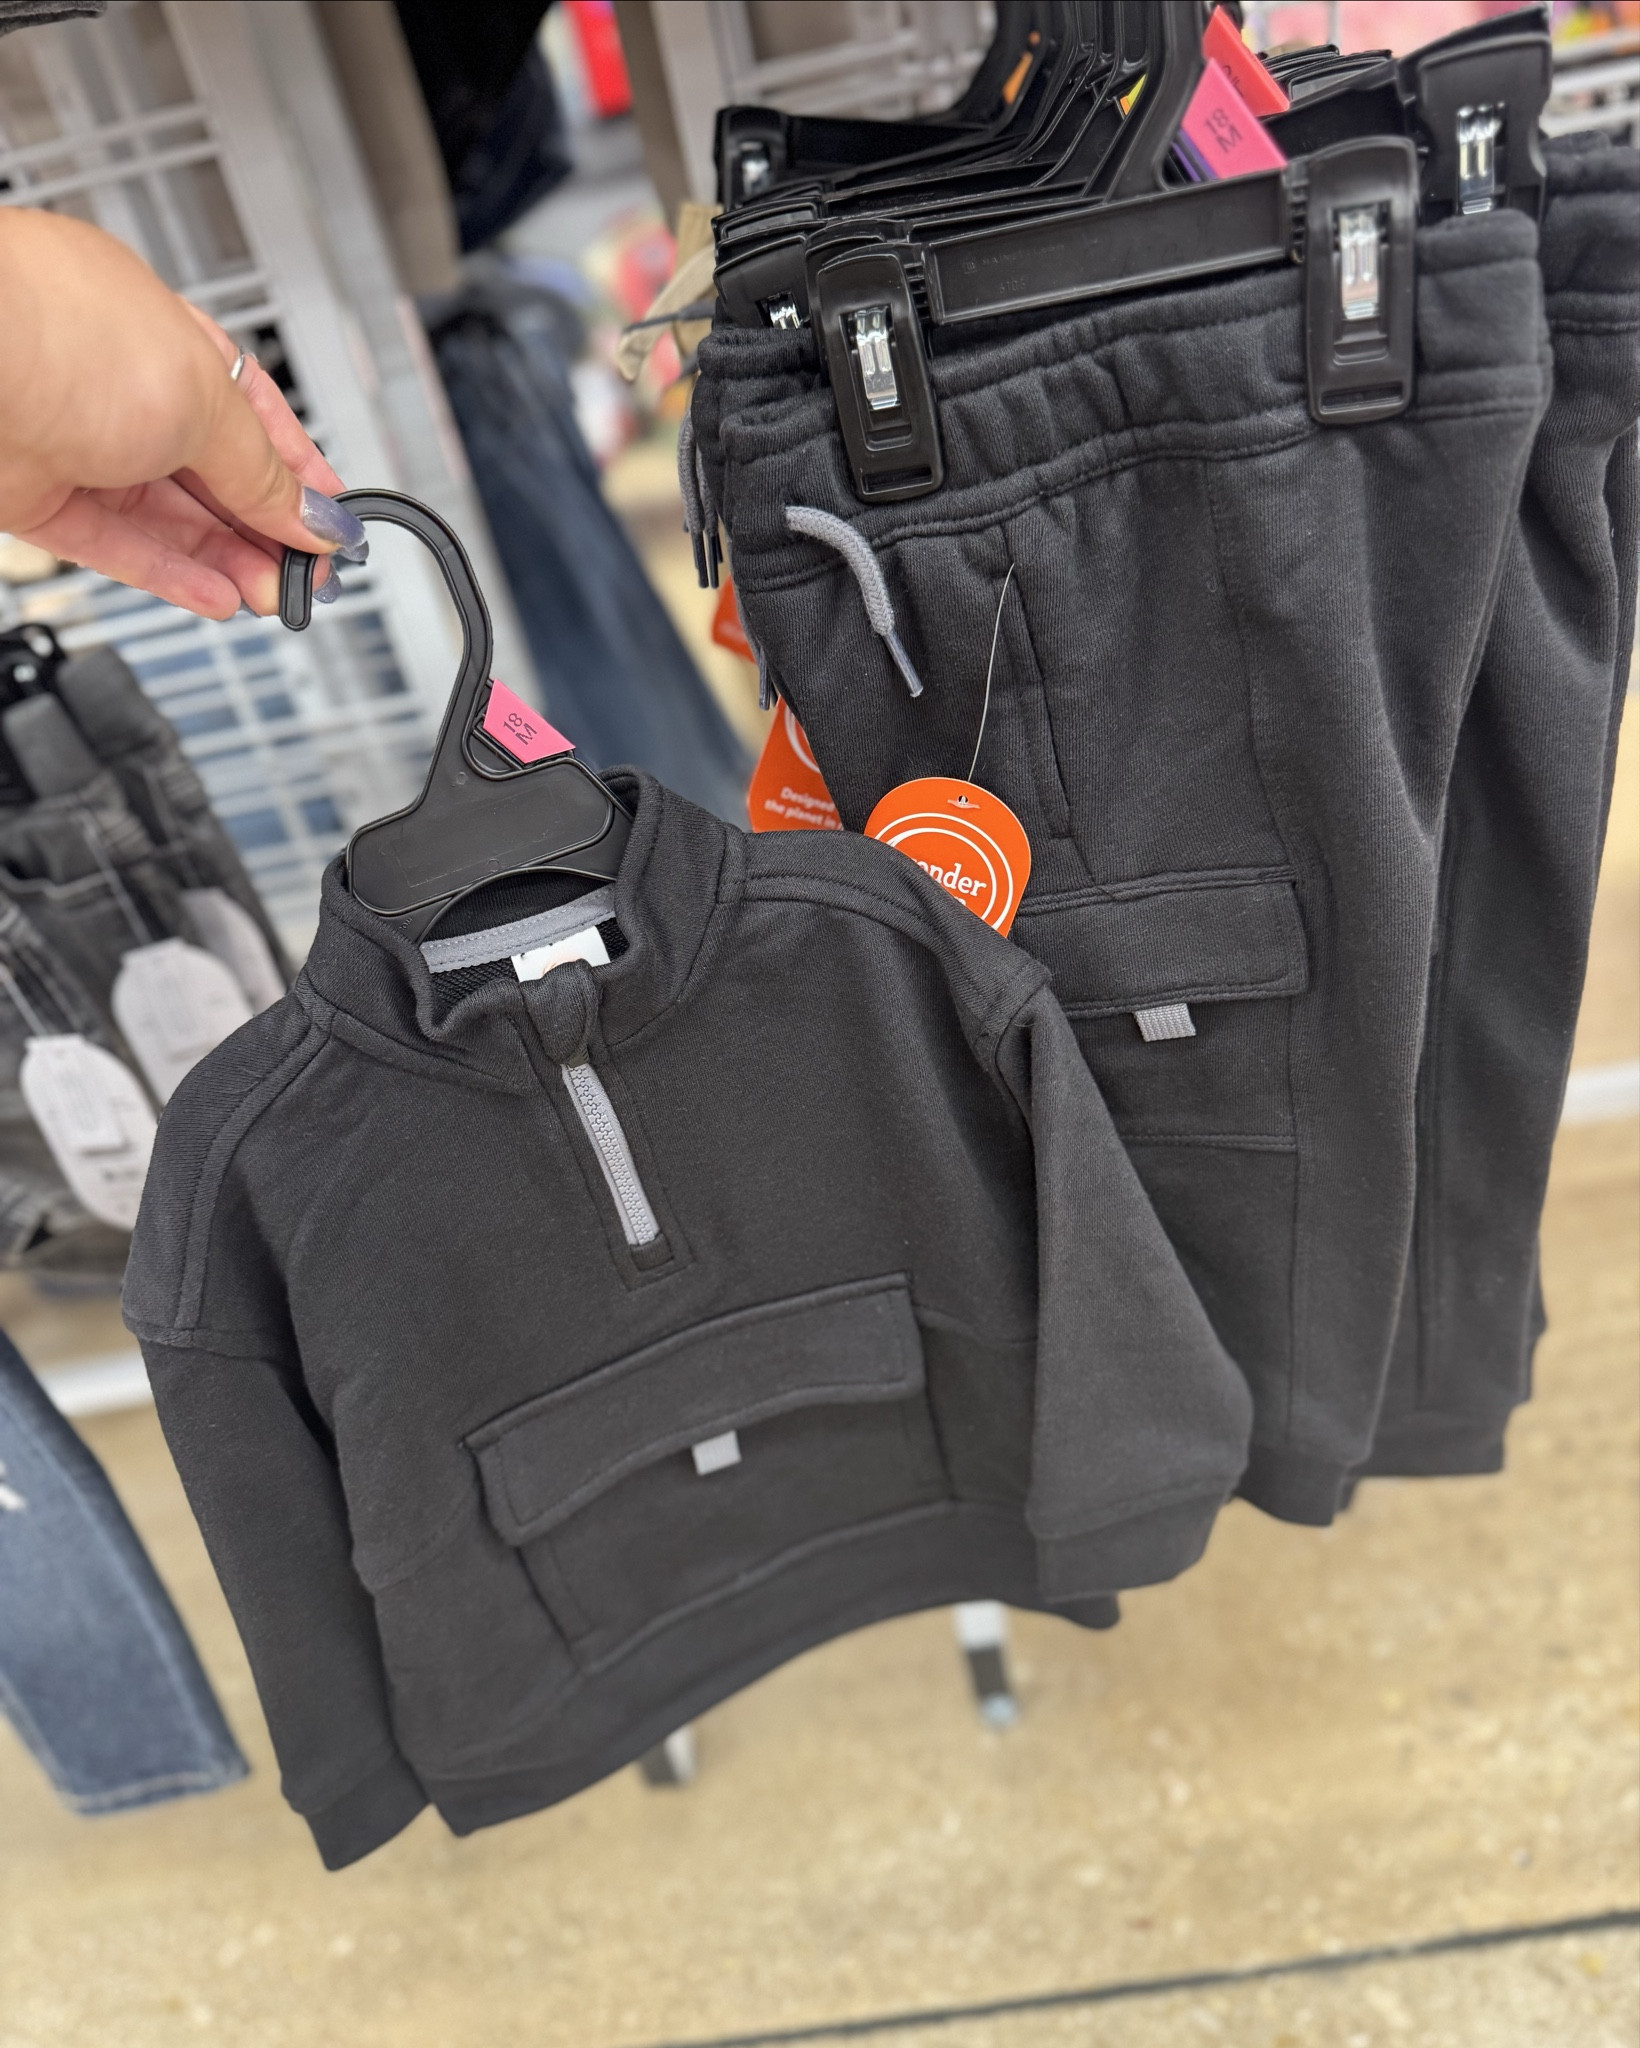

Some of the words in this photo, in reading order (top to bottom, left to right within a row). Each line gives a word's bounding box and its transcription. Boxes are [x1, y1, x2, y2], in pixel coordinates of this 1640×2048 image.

[1205, 108, 1229, 136] 18
[1215, 123, 1242, 154] M
[503, 712, 523, 733] 18
[515, 722, 538, 746] M
[764, 799, 786, 814] the
[785, 806, 824, 826] planet
[911, 858, 987, 897] onder
